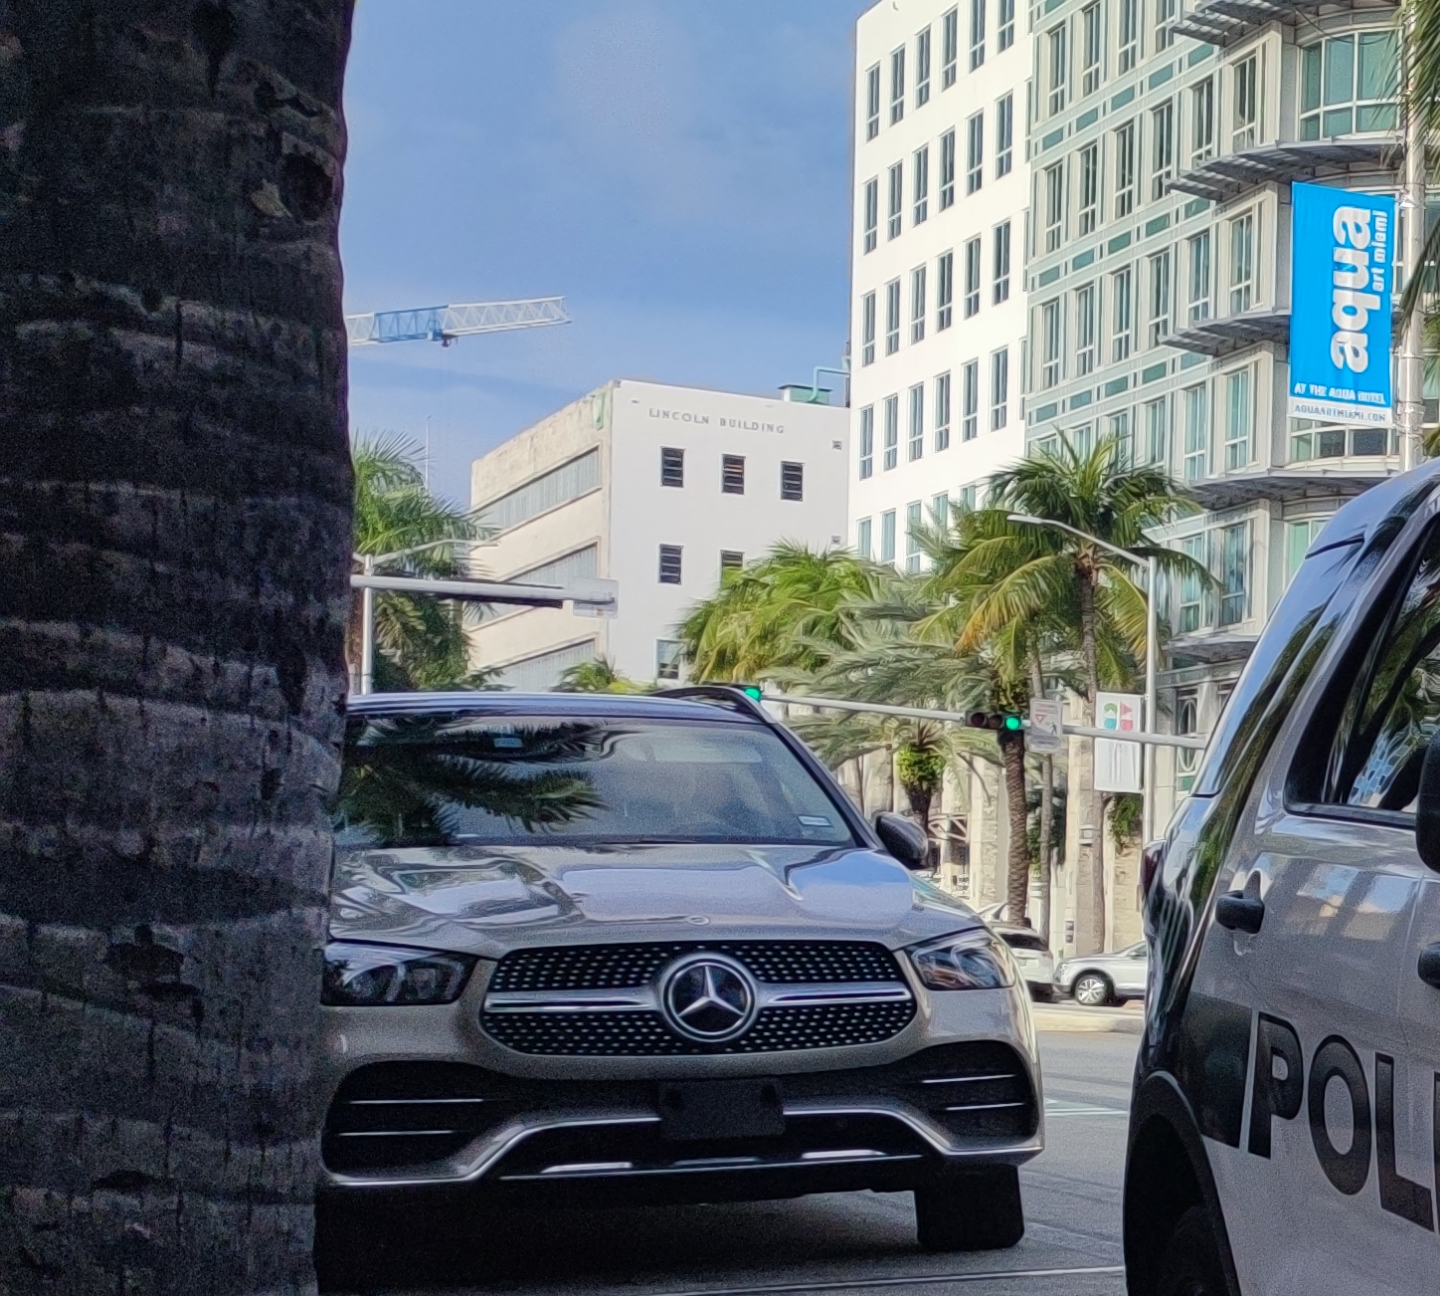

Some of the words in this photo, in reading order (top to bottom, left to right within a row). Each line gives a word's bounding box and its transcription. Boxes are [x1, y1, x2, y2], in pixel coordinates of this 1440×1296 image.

[1373, 209, 1388, 264] miami
[1330, 205, 1382, 373] aqua
[1372, 267, 1385, 292] art
[1294, 382, 1307, 395] AT
[1309, 384, 1327, 397] THE
[1329, 387, 1356, 401] AQUA
[649, 407, 709, 425] LINCOLN
[719, 417, 785, 434] BUILDING
